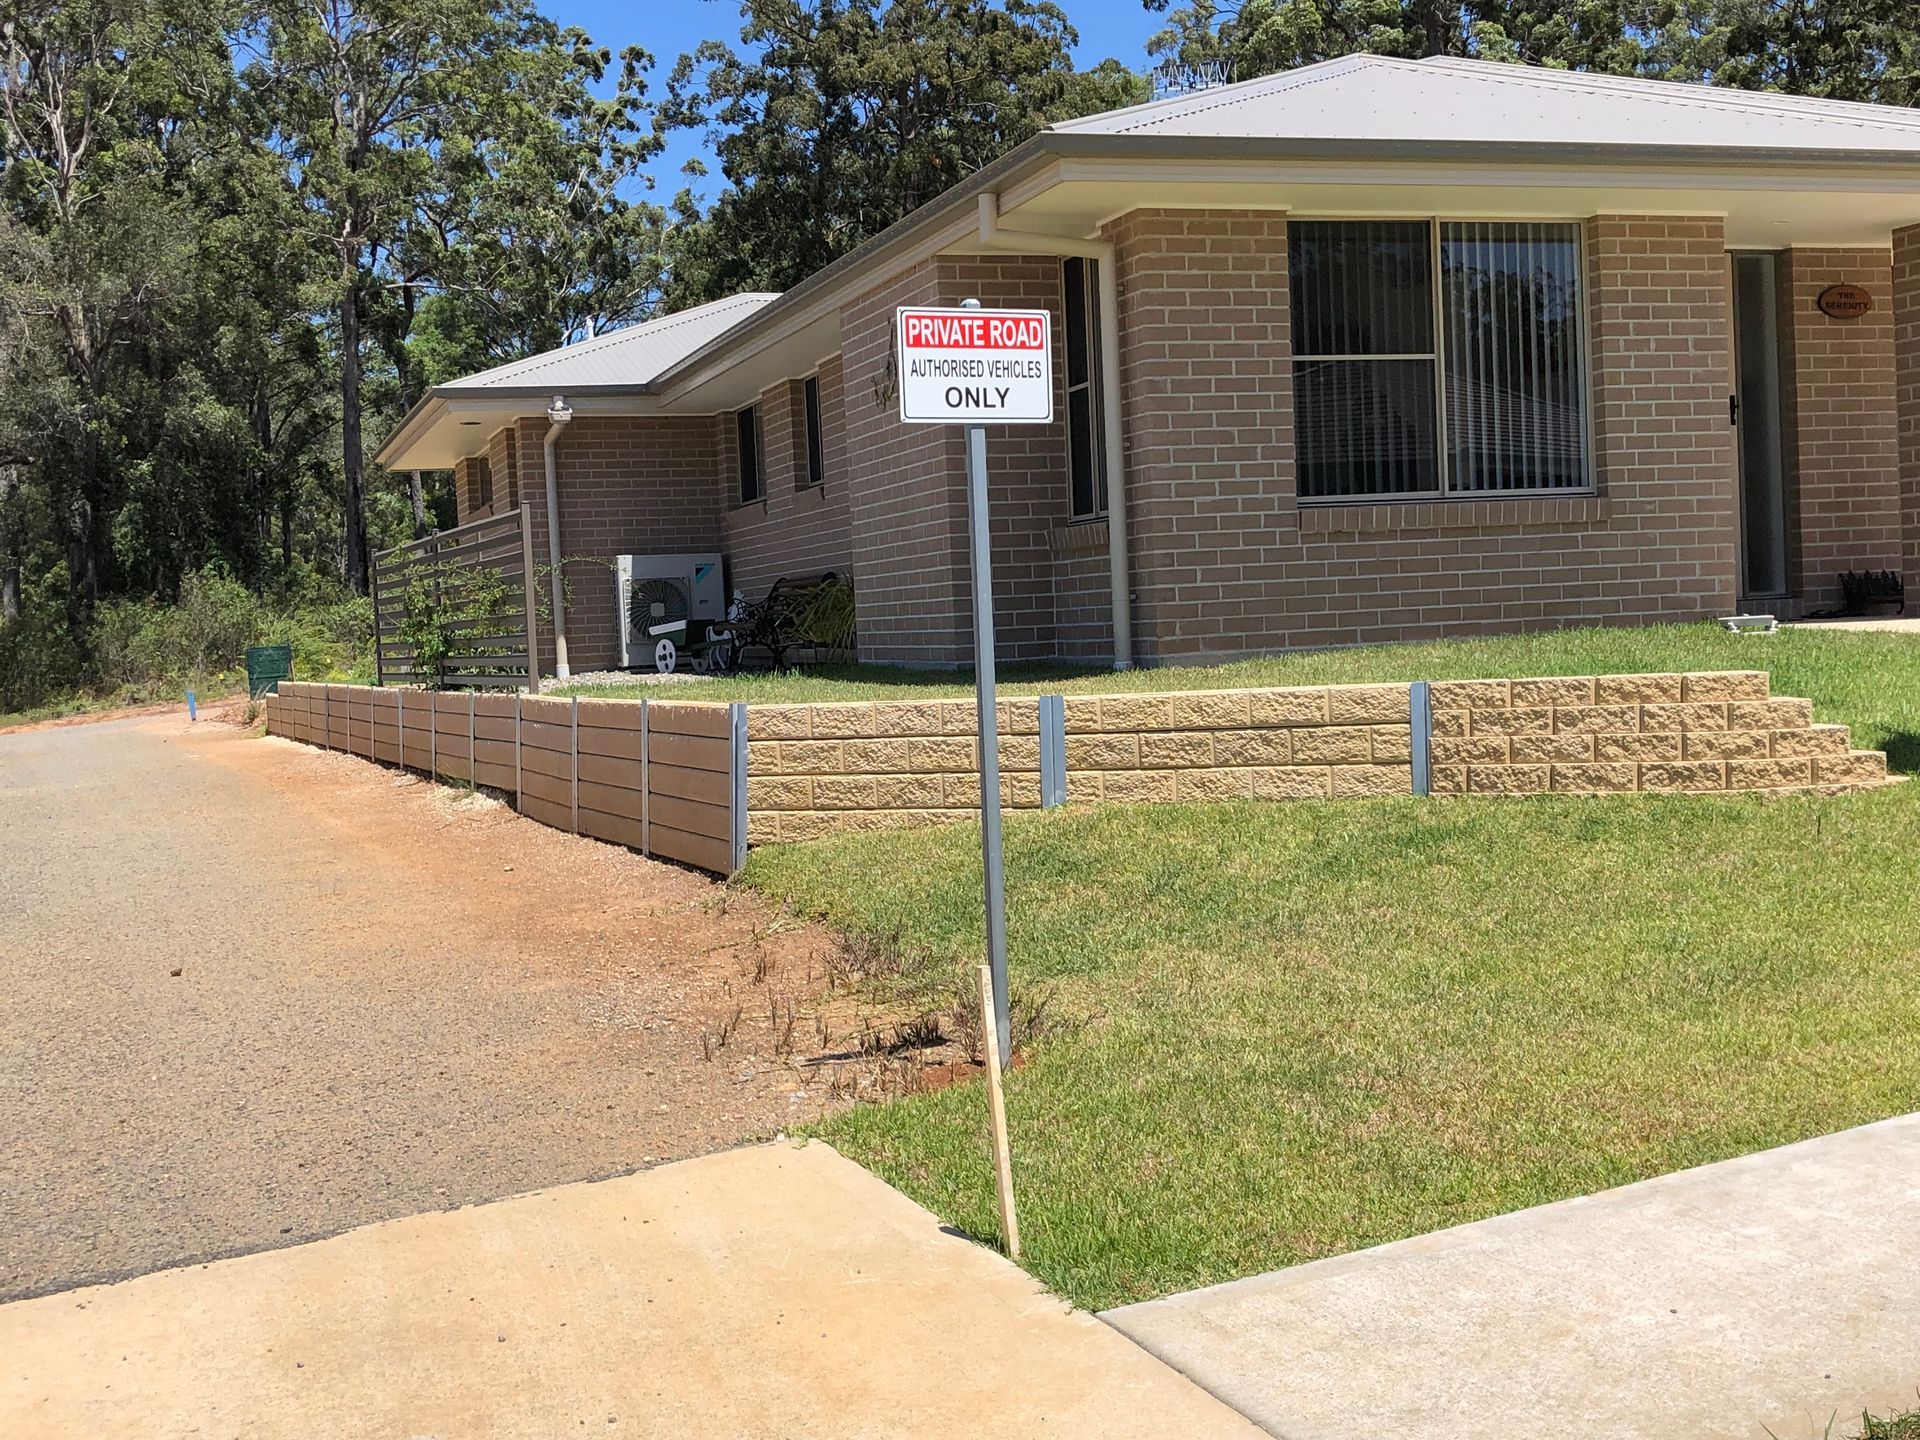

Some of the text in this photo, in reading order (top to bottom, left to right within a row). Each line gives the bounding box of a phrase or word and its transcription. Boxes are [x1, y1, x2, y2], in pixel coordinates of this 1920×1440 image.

[1837, 291, 1856, 299] THE
[1825, 301, 1868, 310] SERENITY
[908, 318, 1042, 348] PRIVATE ROAD
[910, 359, 1042, 379] AUTHORISED VEHICLES
[945, 386, 1010, 409] ONLY
